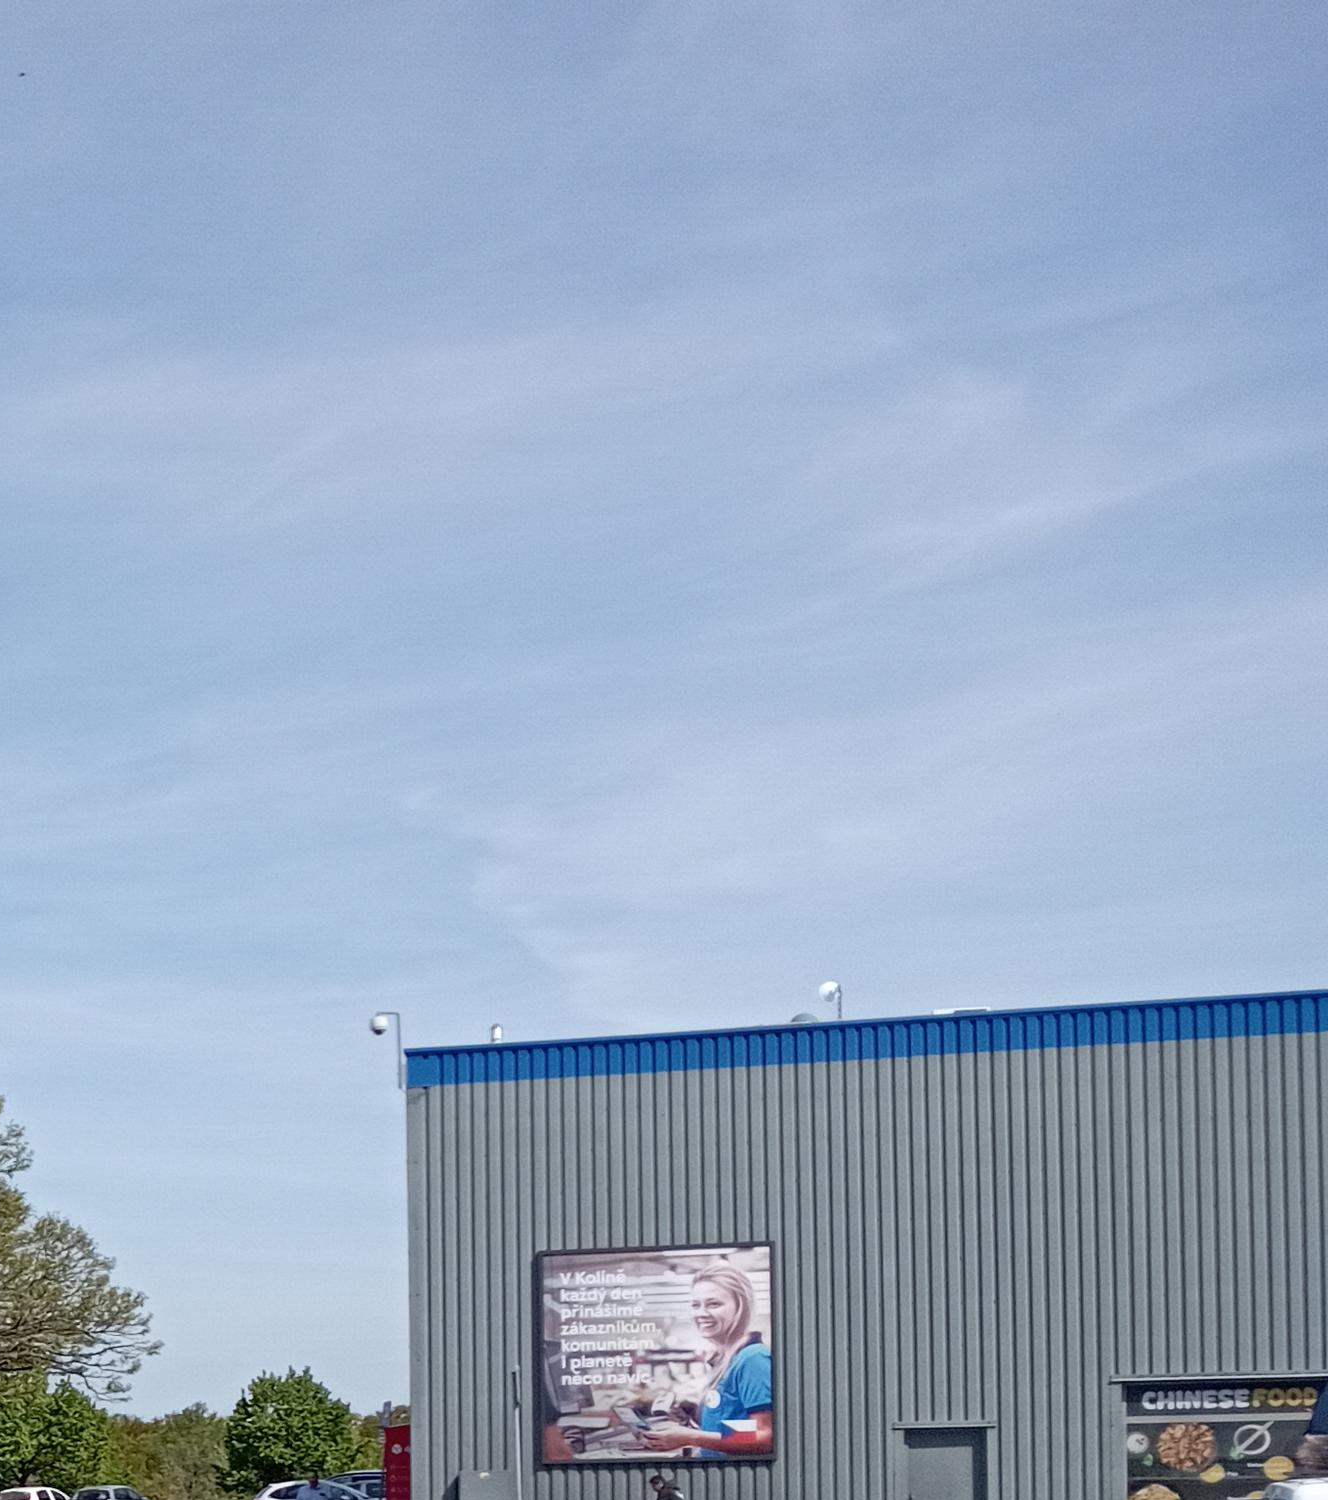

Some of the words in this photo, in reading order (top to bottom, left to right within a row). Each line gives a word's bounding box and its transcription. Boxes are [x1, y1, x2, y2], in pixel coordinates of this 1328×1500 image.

[610, 1288, 643, 1300] den
[1142, 1388, 1250, 1410] CHINESE
[1251, 1386, 1318, 1408] FOOD
